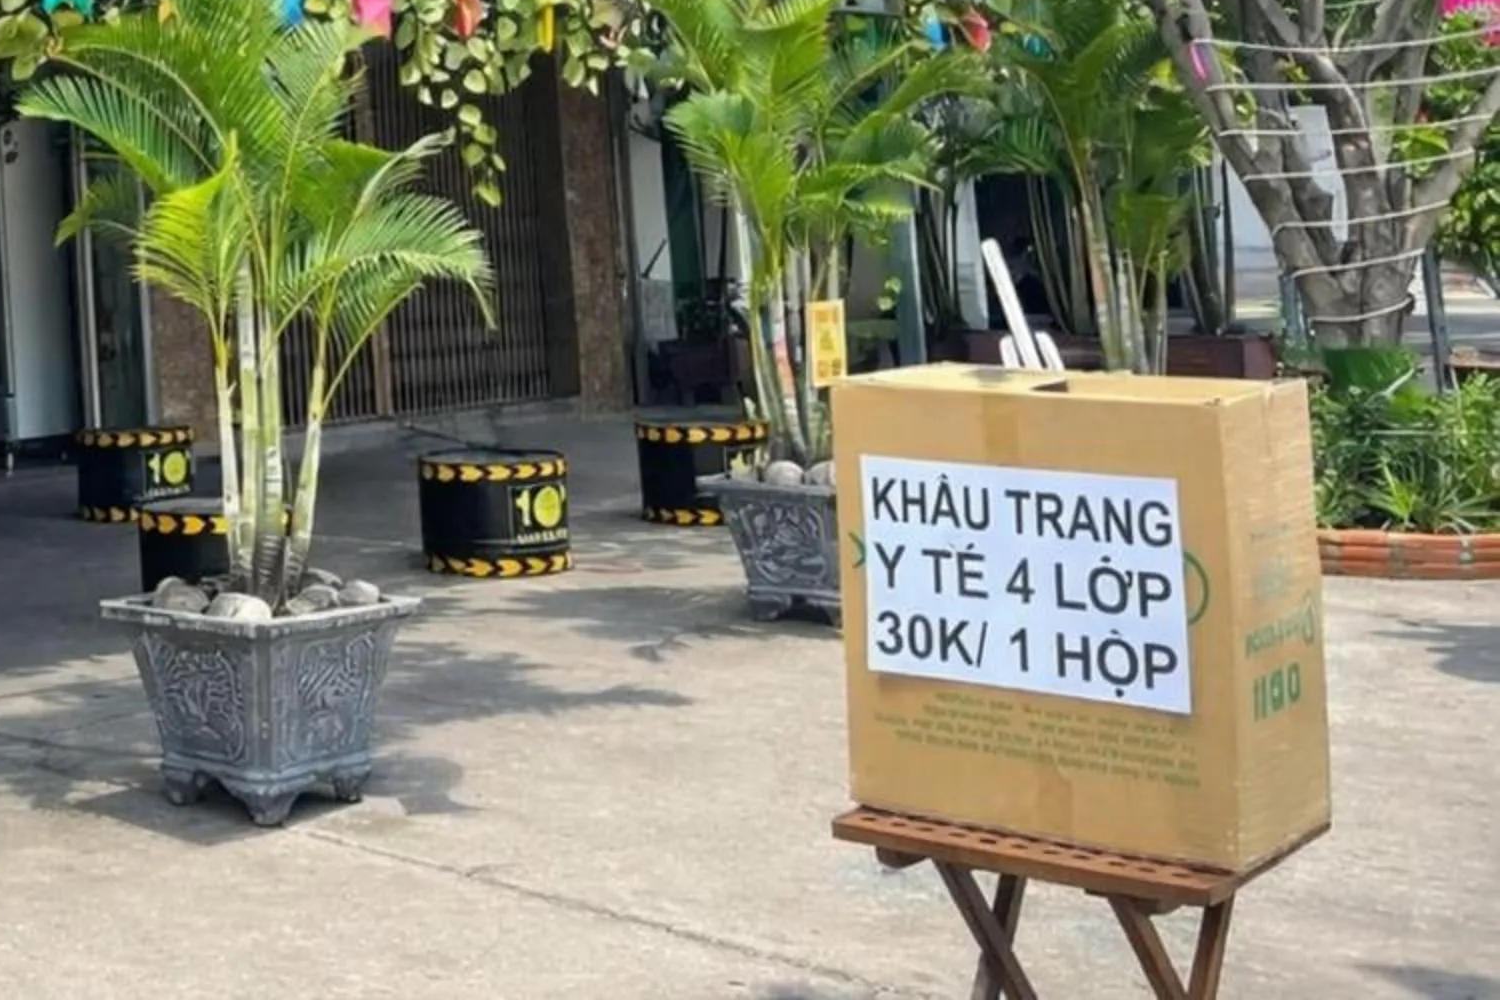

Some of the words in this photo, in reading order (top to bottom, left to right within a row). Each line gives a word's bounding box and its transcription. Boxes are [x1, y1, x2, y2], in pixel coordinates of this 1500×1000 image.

[1004, 489, 1173, 547] TRANG
[873, 541, 906, 590] Y
[1005, 557, 1035, 605] 4
[876, 610, 989, 669] 30K/
[1009, 627, 1030, 673] 1
